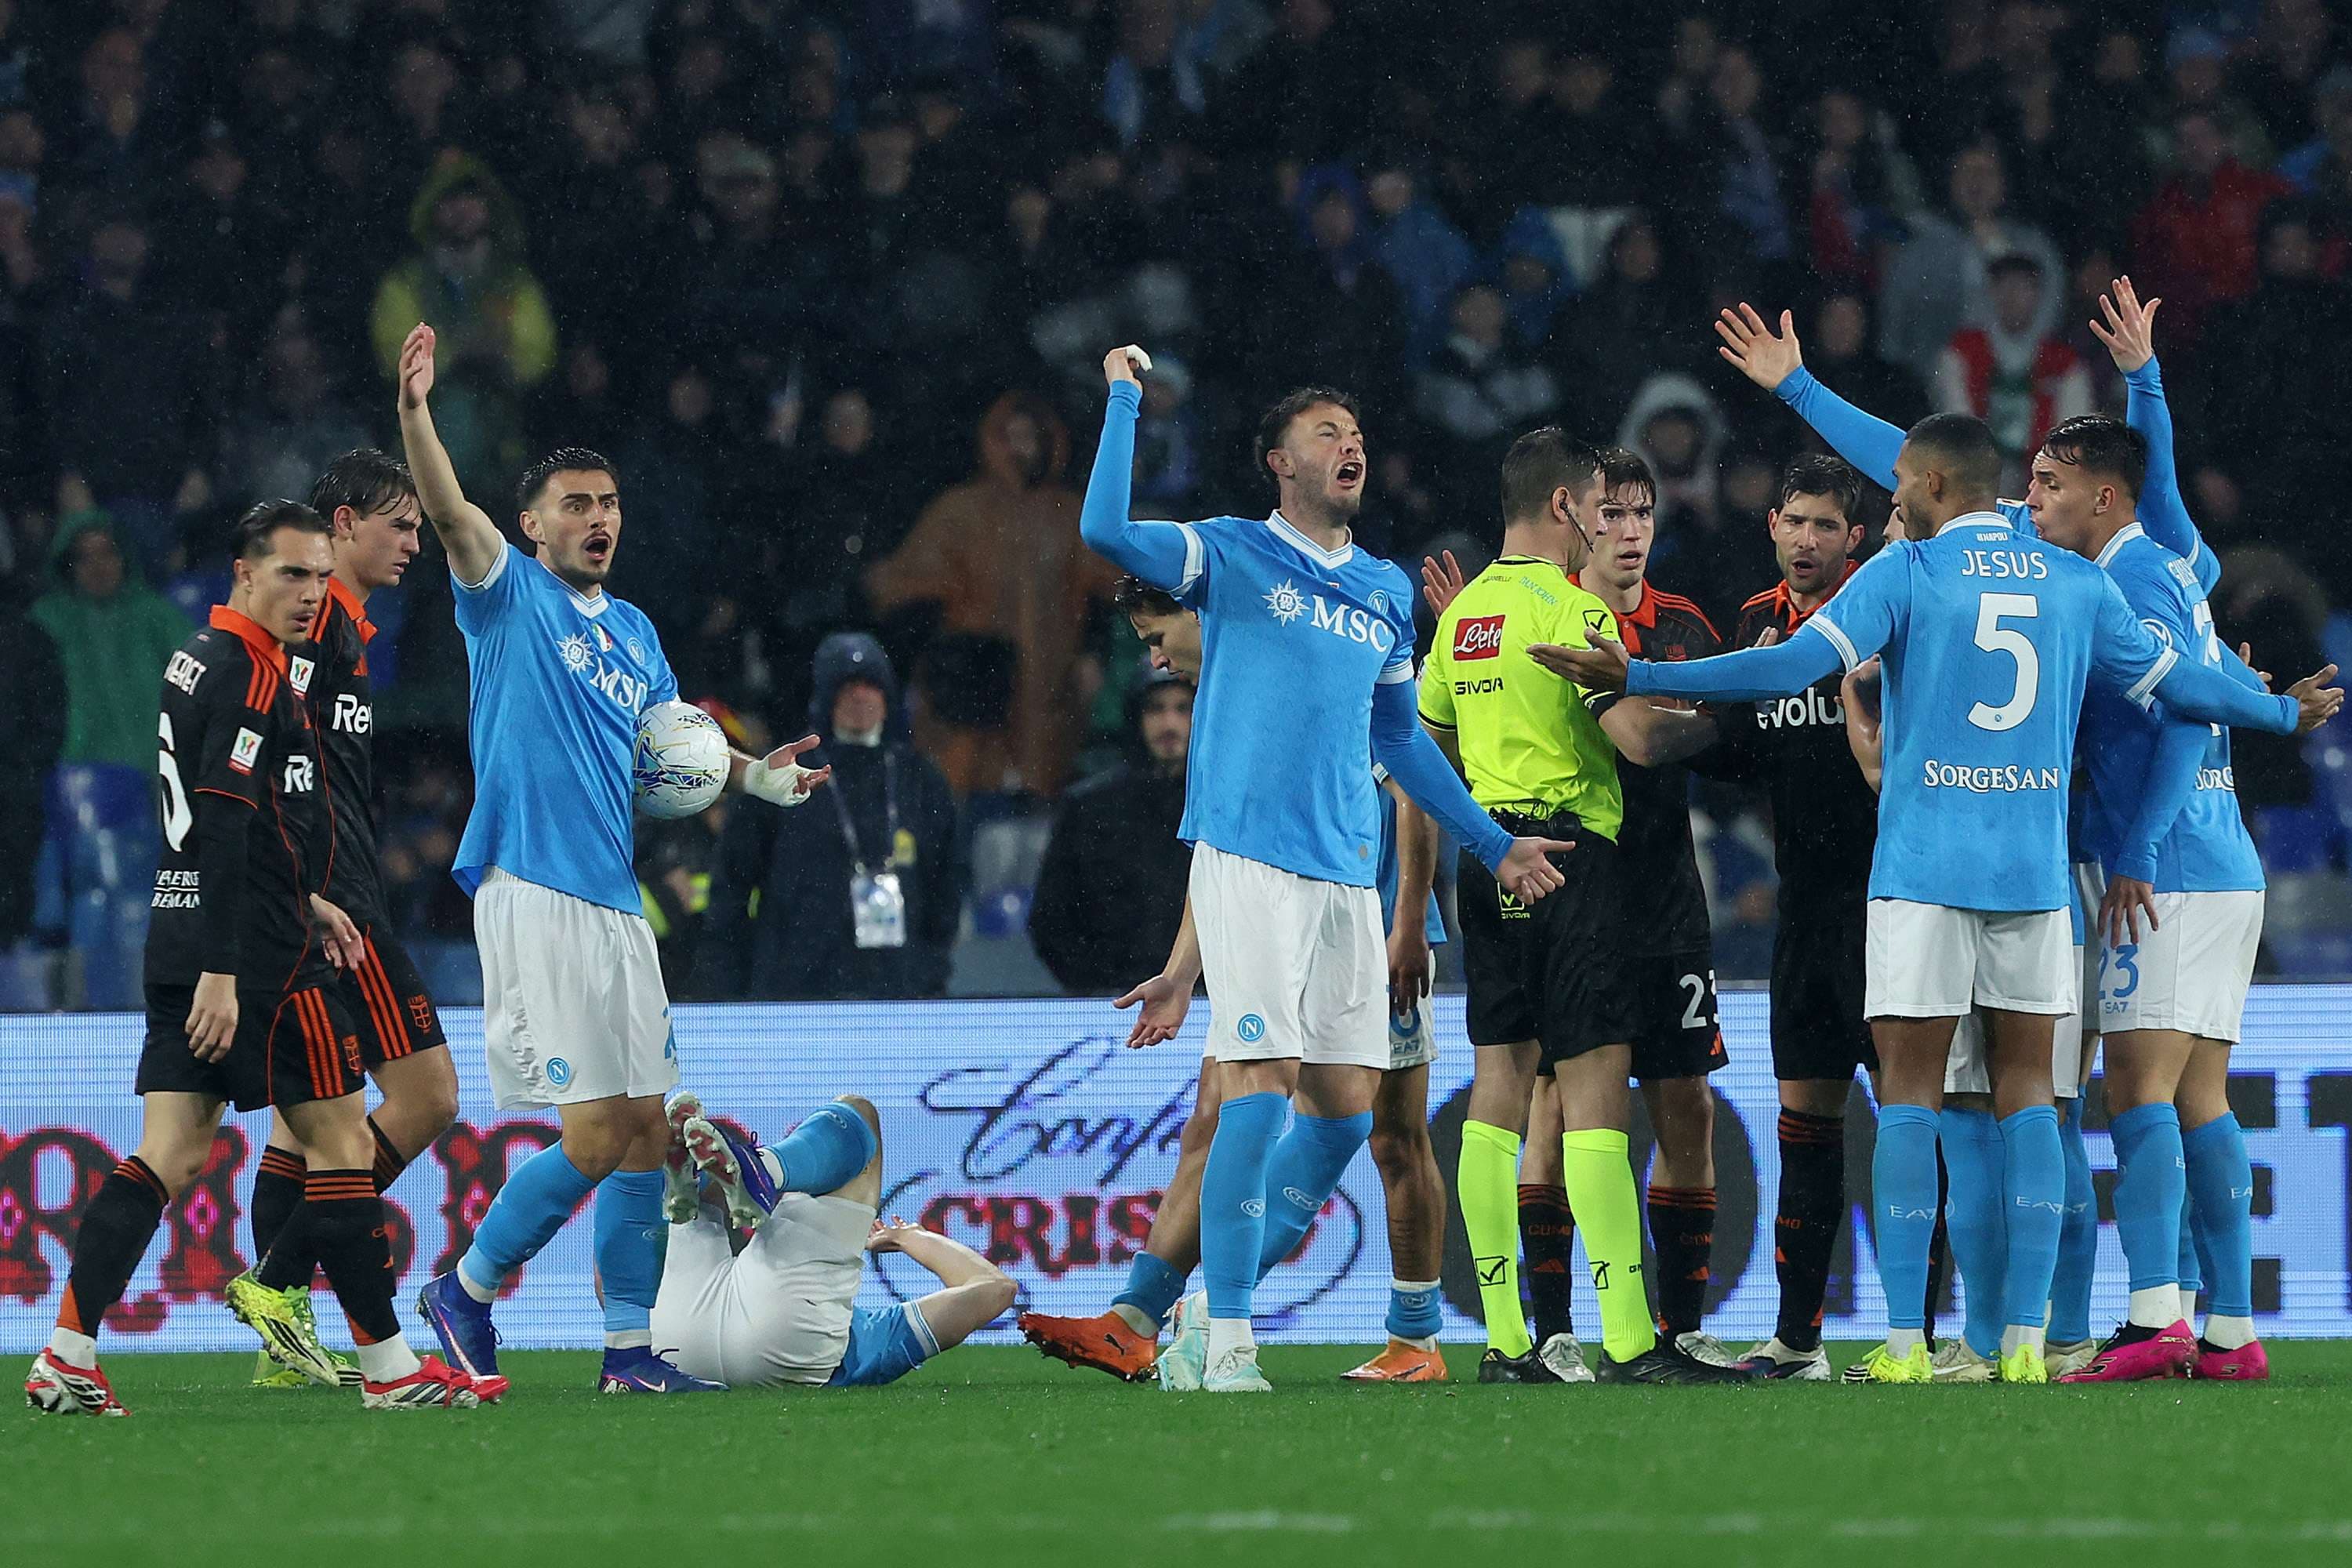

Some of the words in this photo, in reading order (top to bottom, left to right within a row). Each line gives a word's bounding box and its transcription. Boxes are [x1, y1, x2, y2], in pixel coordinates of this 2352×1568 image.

[1962, 550, 2048, 579] JESUS
[1310, 594, 1389, 652] MSC
[1454, 622, 1502, 653] Lete
[1967, 592, 2039, 731] 5
[1924, 758, 2060, 793] SORGESAN
[2104, 1001, 2129, 1014] EA7
